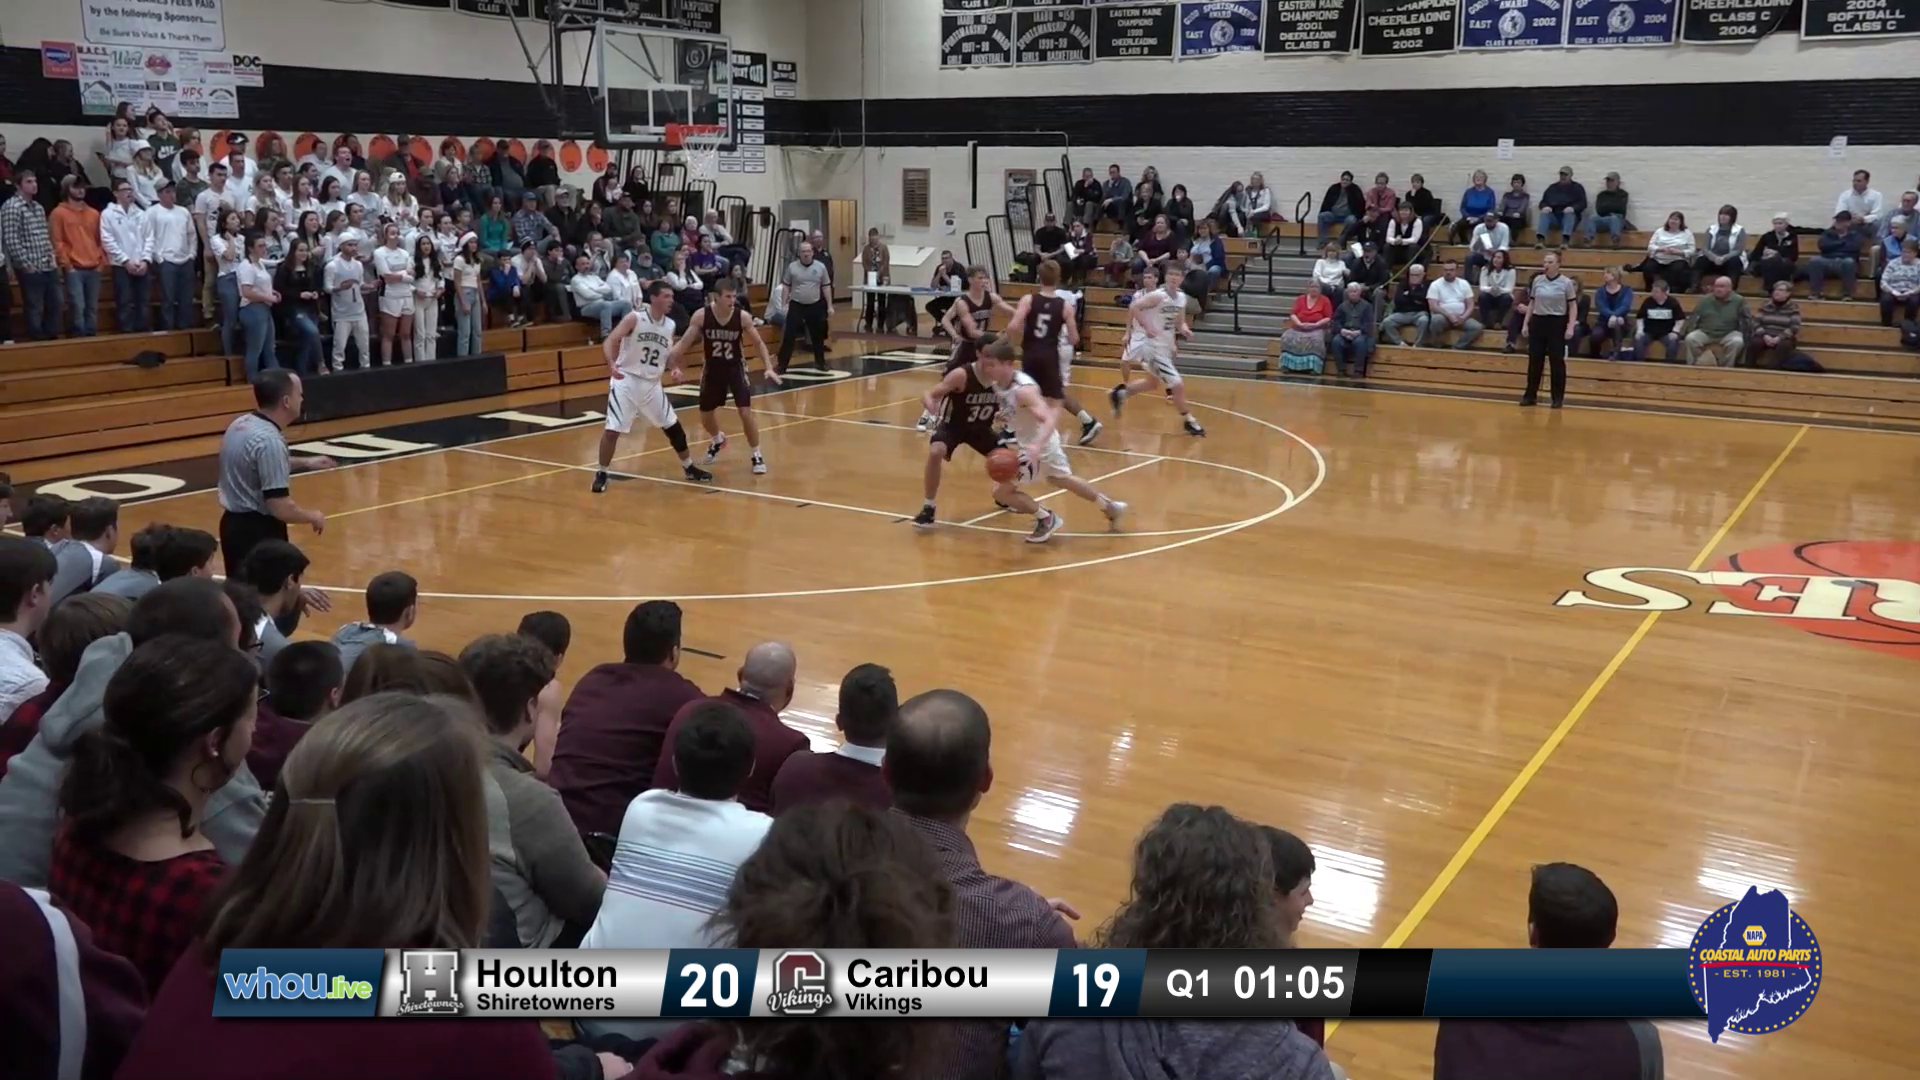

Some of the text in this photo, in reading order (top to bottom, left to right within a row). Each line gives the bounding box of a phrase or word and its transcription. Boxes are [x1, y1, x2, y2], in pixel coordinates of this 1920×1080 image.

[195, 0, 216, 9] PAID
[1278, 0, 1344, 11] EASTERN MAINE
[1499, 0, 1529, 9] AWARD
[1846, 0, 1888, 10] 2004
[90, 6, 101, 17] by
[104, 7, 119, 17] the
[121, 8, 162, 21] following
[1109, 8, 1163, 18] EASTERN MAINE
[1203, 3, 1259, 22] SPORTSMANSHIP
[1209, 11, 1232, 19] AWARD
[1280, 9, 1340, 22] CHAMPIONS
[1709, 11, 1772, 23] CLASS C
[1827, 9, 1906, 22] SOFTBALL
[1117, 18, 1154, 27] CHAMPIONS
[1368, 10, 1452, 27] CHEERLEADING
[1532, 17, 1557, 27] 2002
[1575, 16, 1599, 26] EAST
[1643, 15, 1668, 24] 2004
[1296, 22, 1323, 31] 2001
[1469, 20, 1491, 29] EAST
[1833, 20, 1897, 33] CLASS C
[100, 28, 110, 36] Be
[112, 29, 130, 38] Sure
[141, 31, 159, 39] Visit
[160, 31, 166, 39] &
[168, 32, 191, 42] Thank
[192, 34, 212, 42] Them
[1017, 21, 1090, 50] SPORTSMANSHIP AWARD
[1185, 30, 1205, 39] EAST
[1279, 30, 1338, 41] CHEERLEADING
[1383, 28, 1421, 38] CLASS
[1718, 26, 1758, 36] 2004
[942, 24, 1011, 53] SPORTSMANSHIP AWARD
[1112, 38, 1158, 47] CHEERLEADING
[1485, 39, 1506, 47] CLASS
[1514, 38, 1539, 46] HOCKEY
[1627, 35, 1665, 43] BASKETBALL
[1285, 40, 1320, 50] CLASS
[1392, 39, 1424, 50] 2002
[1046, 50, 1084, 62] BASKETBALL
[1119, 47, 1141, 55] CLASS
[233, 54, 262, 67] DOC
[971, 53, 1005, 64] BASKETBALL
[178, 101, 208, 111] HOULTON
[1033, 313, 1052, 339] 5
[637, 331, 669, 349] SHIRES
[705, 329, 740, 341] CARIBOU
[712, 341, 734, 361] 22
[640, 346, 661, 368] 32
[967, 405, 996, 423] 30
